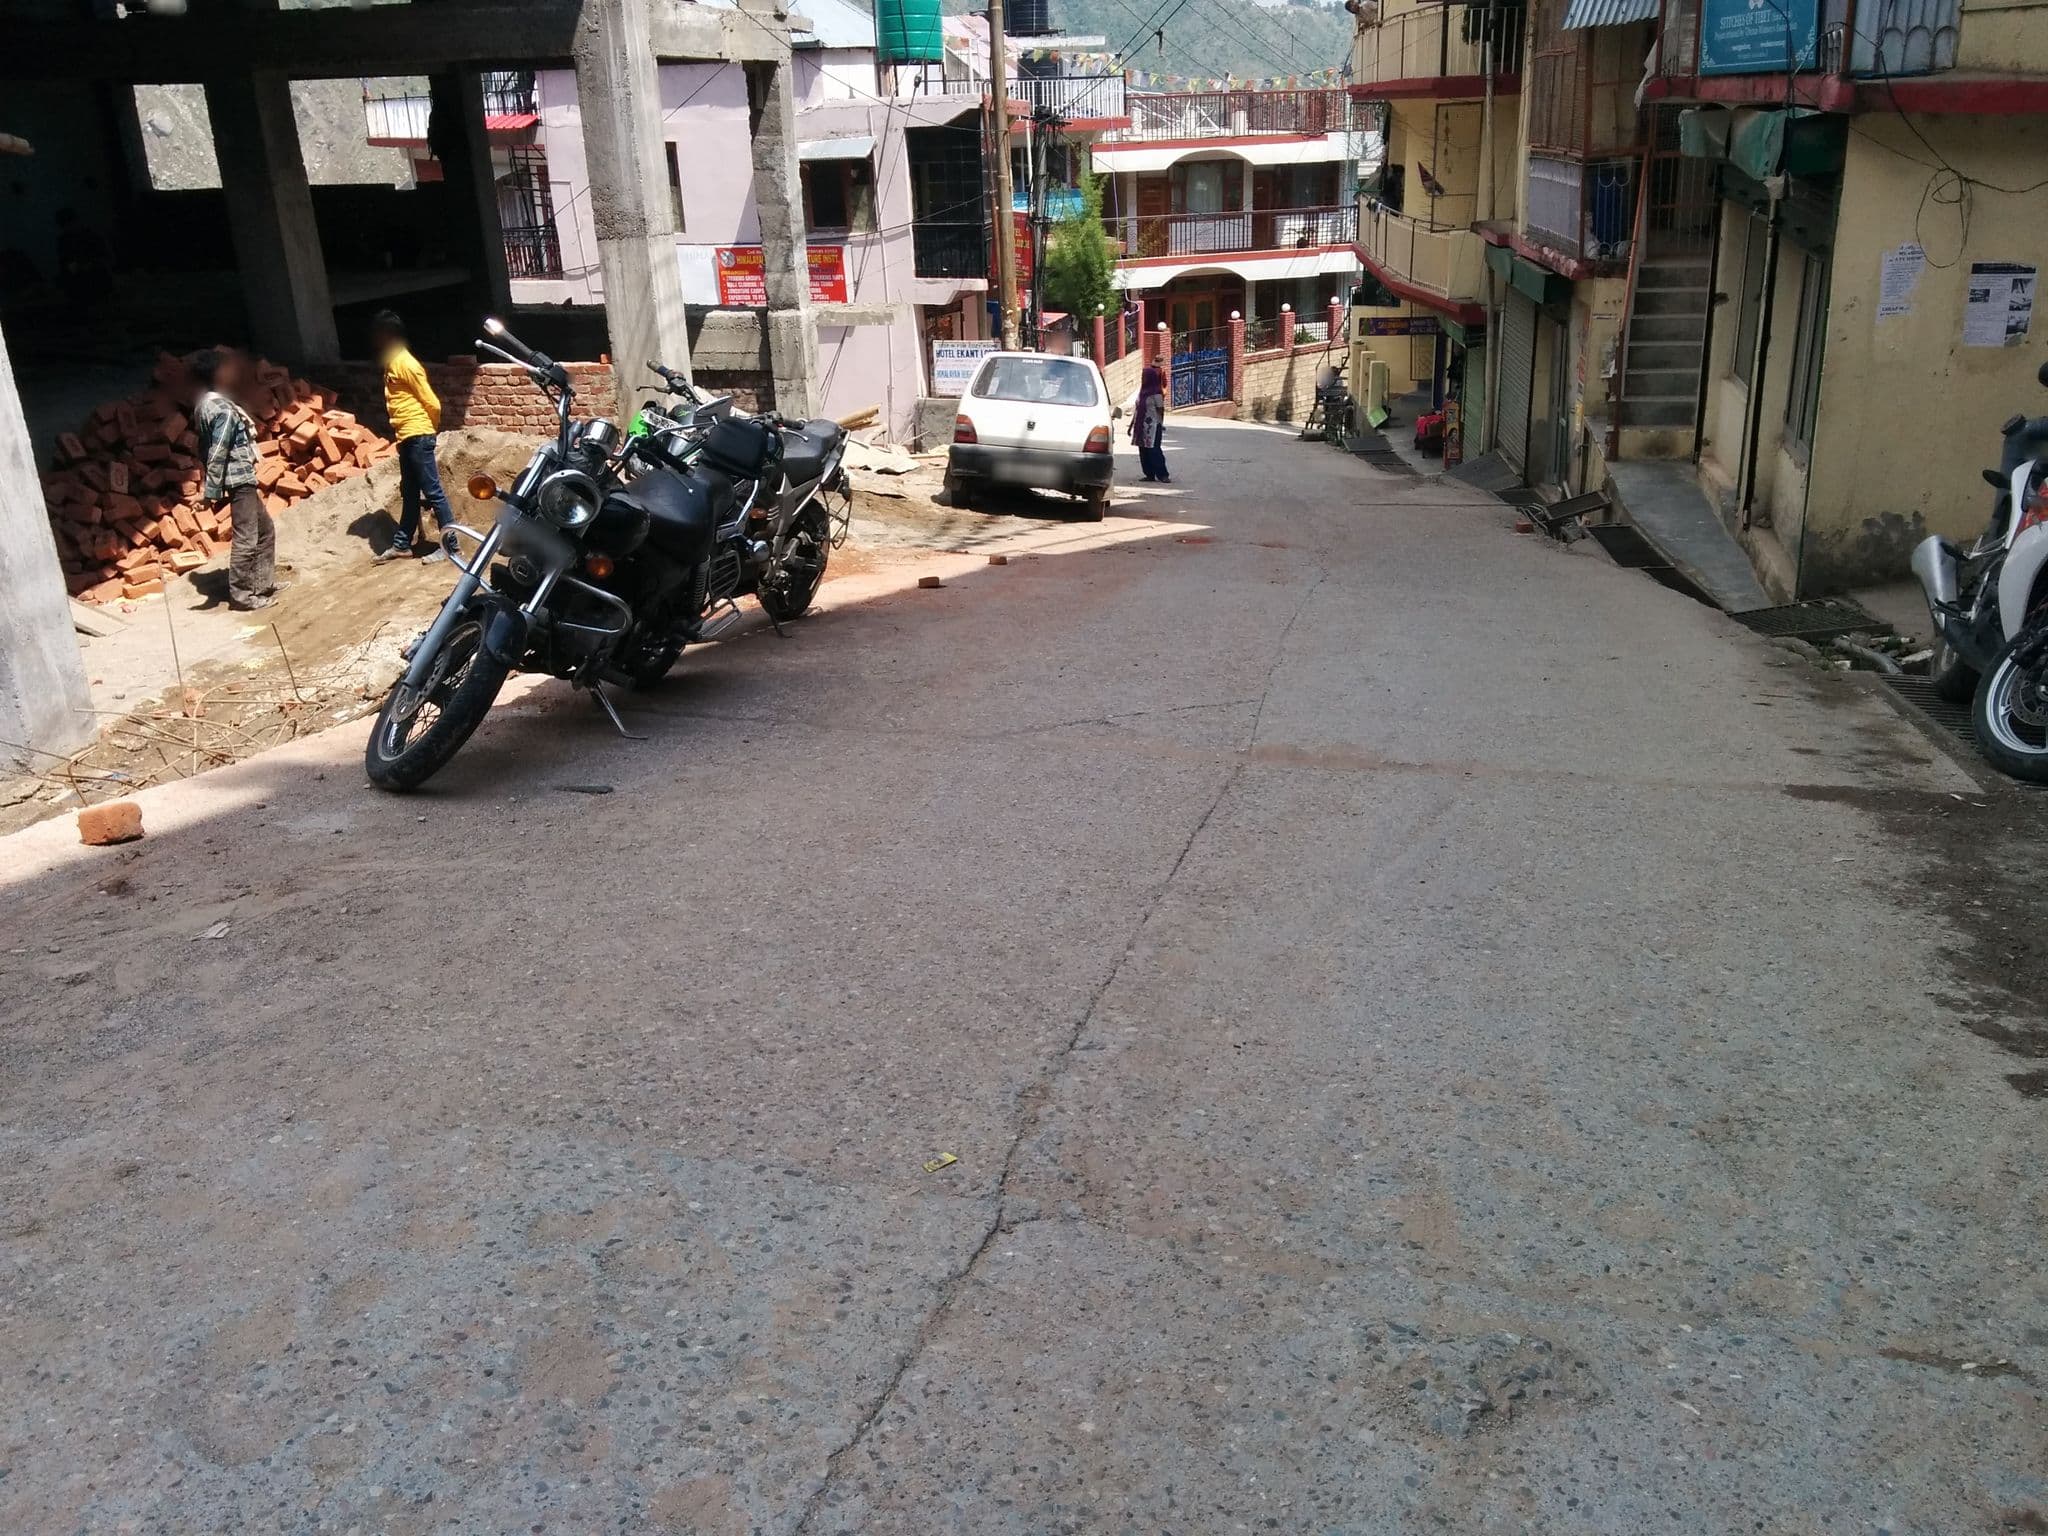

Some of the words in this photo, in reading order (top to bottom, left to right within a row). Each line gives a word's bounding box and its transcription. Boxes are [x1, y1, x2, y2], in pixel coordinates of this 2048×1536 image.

[1755, 9, 1771, 25] TIBET
[736, 255, 765, 265] HIMALAYA
[936, 349, 955, 358] HOTEL
[957, 349, 979, 358] EKANT
